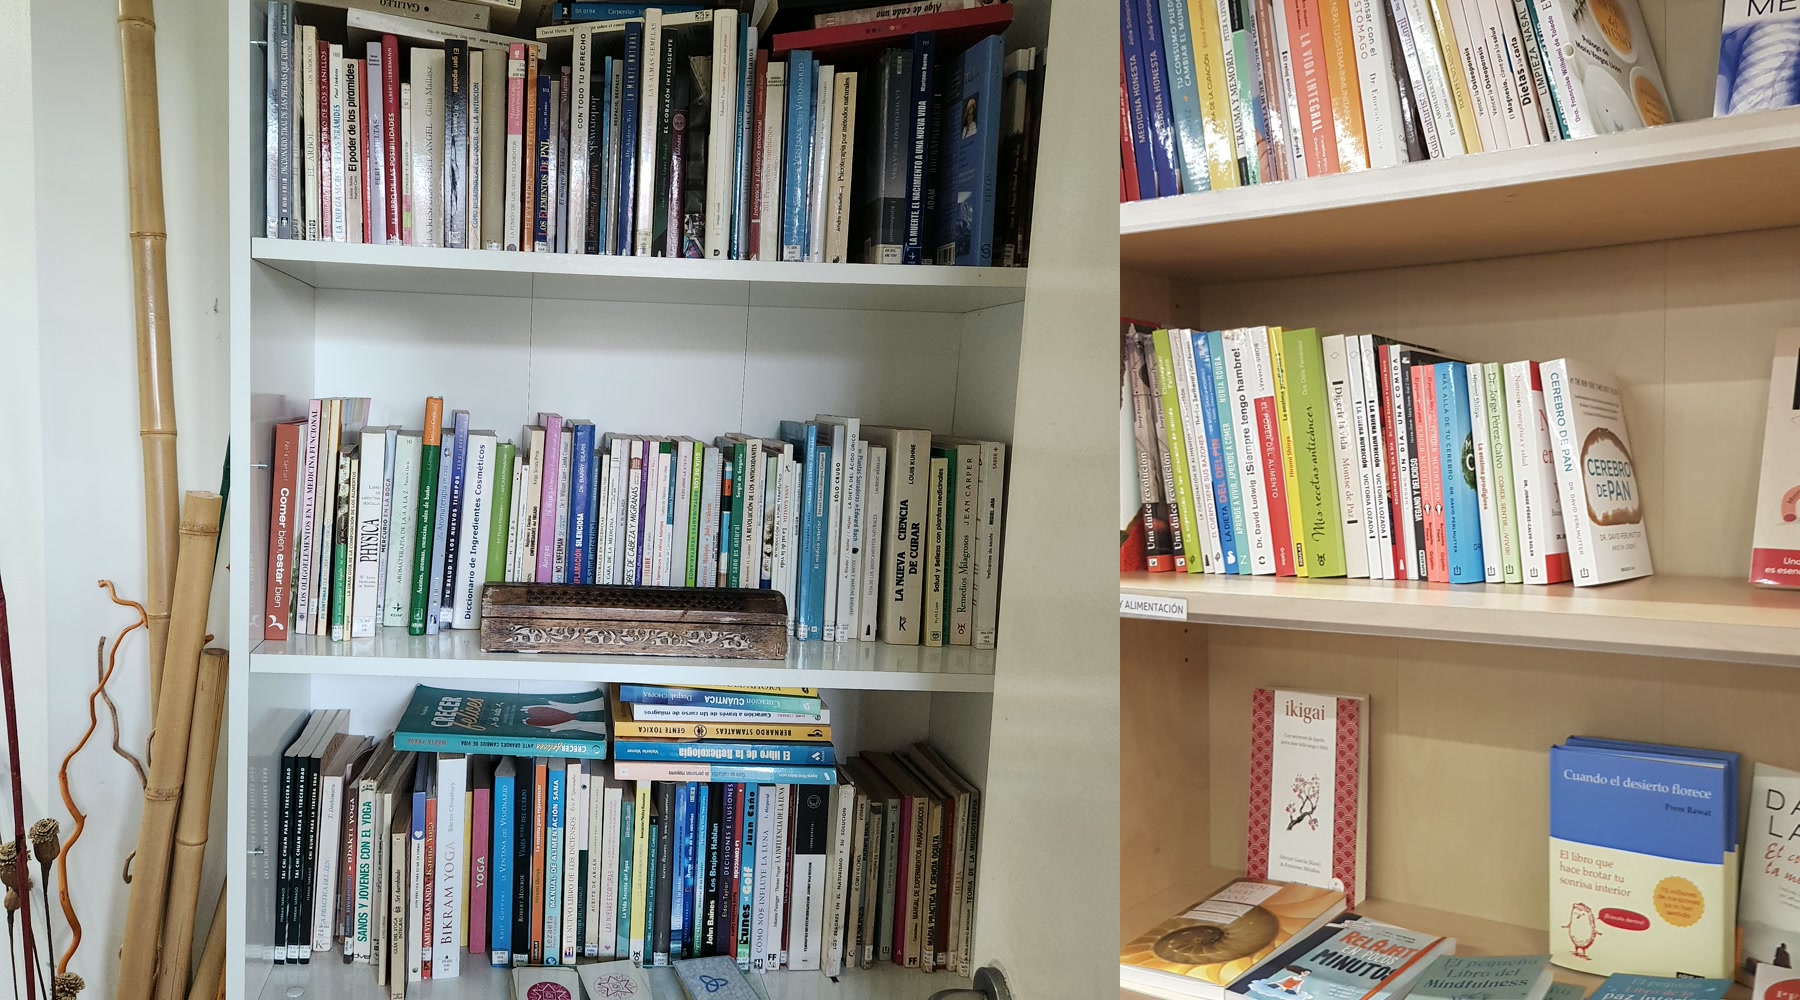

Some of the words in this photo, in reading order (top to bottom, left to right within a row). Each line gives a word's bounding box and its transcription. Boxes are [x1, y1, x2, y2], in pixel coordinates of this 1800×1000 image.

[380, 0, 419, 12] GALILEO
[876, 10, 889, 18] uno
[893, 8, 910, 16] cada
[912, 7, 922, 15] de
[924, 3, 942, 13] Algo
[1519, 8, 1533, 42] NASAL
[1300, 33, 1310, 46] LA
[1226, 50, 1237, 96] MEMORIA
[1302, 49, 1315, 76] VIDA
[1464, 47, 1478, 90] Osteoporosis
[1529, 47, 1547, 96] LIMPIEZA
[345, 64, 356, 107] pirámides
[579, 75, 585, 85] TU
[1130, 55, 1140, 96] HONESTA
[347, 110, 355, 122] las
[918, 101, 926, 117] VIDA
[1304, 80, 1323, 133] INTEGRAL
[1473, 96, 1484, 116] Vencer
[347, 125, 356, 135] de
[917, 118, 925, 139] NUEVA
[1135, 98, 1145, 143] MEDICINA
[1232, 106, 1245, 148] TRAUMA
[348, 137, 357, 162] poder
[541, 139, 549, 158] PNL
[916, 141, 924, 154] UNA
[348, 164, 356, 172] El
[912, 161, 922, 200] NACIMIENTO
[539, 173, 548, 218] ELEMENTOS
[910, 210, 919, 237] MUERTE,
[1214, 357, 1223, 378] ROURA
[1231, 348, 1245, 392] hambre!
[1216, 380, 1226, 403] NURIA
[1550, 373, 1566, 427] CEREBRO
[1238, 395, 1250, 425] tengo
[309, 409, 318, 454] FUNCIONAL
[1559, 429, 1568, 445] DE
[1241, 428, 1255, 476] ¡Siempre
[1562, 449, 1573, 472] PAN
[306, 456, 315, 494] MEDICINA
[475, 444, 485, 495] Cosméticos
[1139, 452, 1151, 501] revolución
[1587, 459, 1631, 477] CEREBRO
[452, 476, 460, 505] TIEMPOS
[1218, 480, 1228, 503] DEL
[1249, 480, 1260, 509] Ludwig
[1596, 484, 1606, 497] DE
[1607, 480, 1632, 501] PAN
[279, 488, 289, 527] Comer
[306, 497, 313, 508] LA
[306, 510, 312, 518] EN
[470, 498, 481, 554] Ingredientes
[898, 499, 908, 540] CIENCIA
[1144, 504, 1153, 529] dulce
[1221, 505, 1231, 529] DIETA
[1252, 512, 1261, 535] David
[1311, 514, 1326, 541] Mis
[360, 519, 379, 562] PHYSICA
[910, 523, 920, 558] CURAR
[1146, 531, 1156, 549] Una
[1225, 531, 1232, 542] LA
[1255, 537, 1263, 549] Dr.
[301, 521, 311, 590] OLIGOELEMENTOS
[416, 573, 424, 594] Aceites,
[420, 524, 429, 548] esencias,
[448, 553, 454, 562] EN
[468, 558, 476, 568] de
[959, 535, 970, 575] Milagrosos
[445, 566, 453, 587] SALUD
[896, 551, 905, 586] NUEVA
[909, 560, 918, 574] DE
[274, 587, 283, 607] bien
[444, 590, 450, 598] TU
[464, 571, 474, 620] Diccionario
[895, 588, 903, 601] LA
[957, 578, 967, 613] Remedios
[1125, 600, 1183, 614] ALIMENTACIÓN
[1285, 700, 1325, 723] ikigai
[665, 727, 686, 735] GENTE
[715, 728, 753, 736] STAMATEAS
[561, 744, 586, 753] CRECER
[679, 748, 733, 759] Reflexología
[735, 749, 744, 759] la
[746, 750, 757, 759] de
[759, 750, 780, 760] libro
[783, 751, 790, 760] El
[1564, 769, 1608, 784] Cuando
[1610, 776, 1620, 786] el
[1623, 779, 1669, 793] desierto
[1672, 784, 1711, 799] florece
[361, 801, 372, 825] YOGA
[361, 829, 370, 838] EL
[549, 804, 558, 860] ALIMENTACIÓN
[711, 823, 719, 849] Hablan
[360, 842, 370, 860] CON
[443, 841, 455, 880] YOGA
[1560, 850, 1569, 859] El
[1571, 852, 1593, 865] libro
[1596, 859, 1613, 869] que
[476, 856, 485, 888] YOGA
[550, 862, 557, 873] DE
[709, 851, 718, 876] Brujos
[1560, 862, 1581, 875] hace
[1583, 866, 1612, 881] brotar
[1615, 874, 1624, 883] tu
[359, 863, 369, 900] JOVENES
[549, 875, 557, 908] MANUAL
[1560, 876, 1592, 890] sonrisa
[1595, 883, 1631, 897] interior
[441, 886, 454, 944] BIKRAM
[707, 900, 715, 925] Baines
[357, 913, 368, 942] SANOS
[1340, 931, 1419, 958] RELÁJAT
[1341, 946, 1359, 955] EN
[1361, 952, 1399, 965] POCOS
